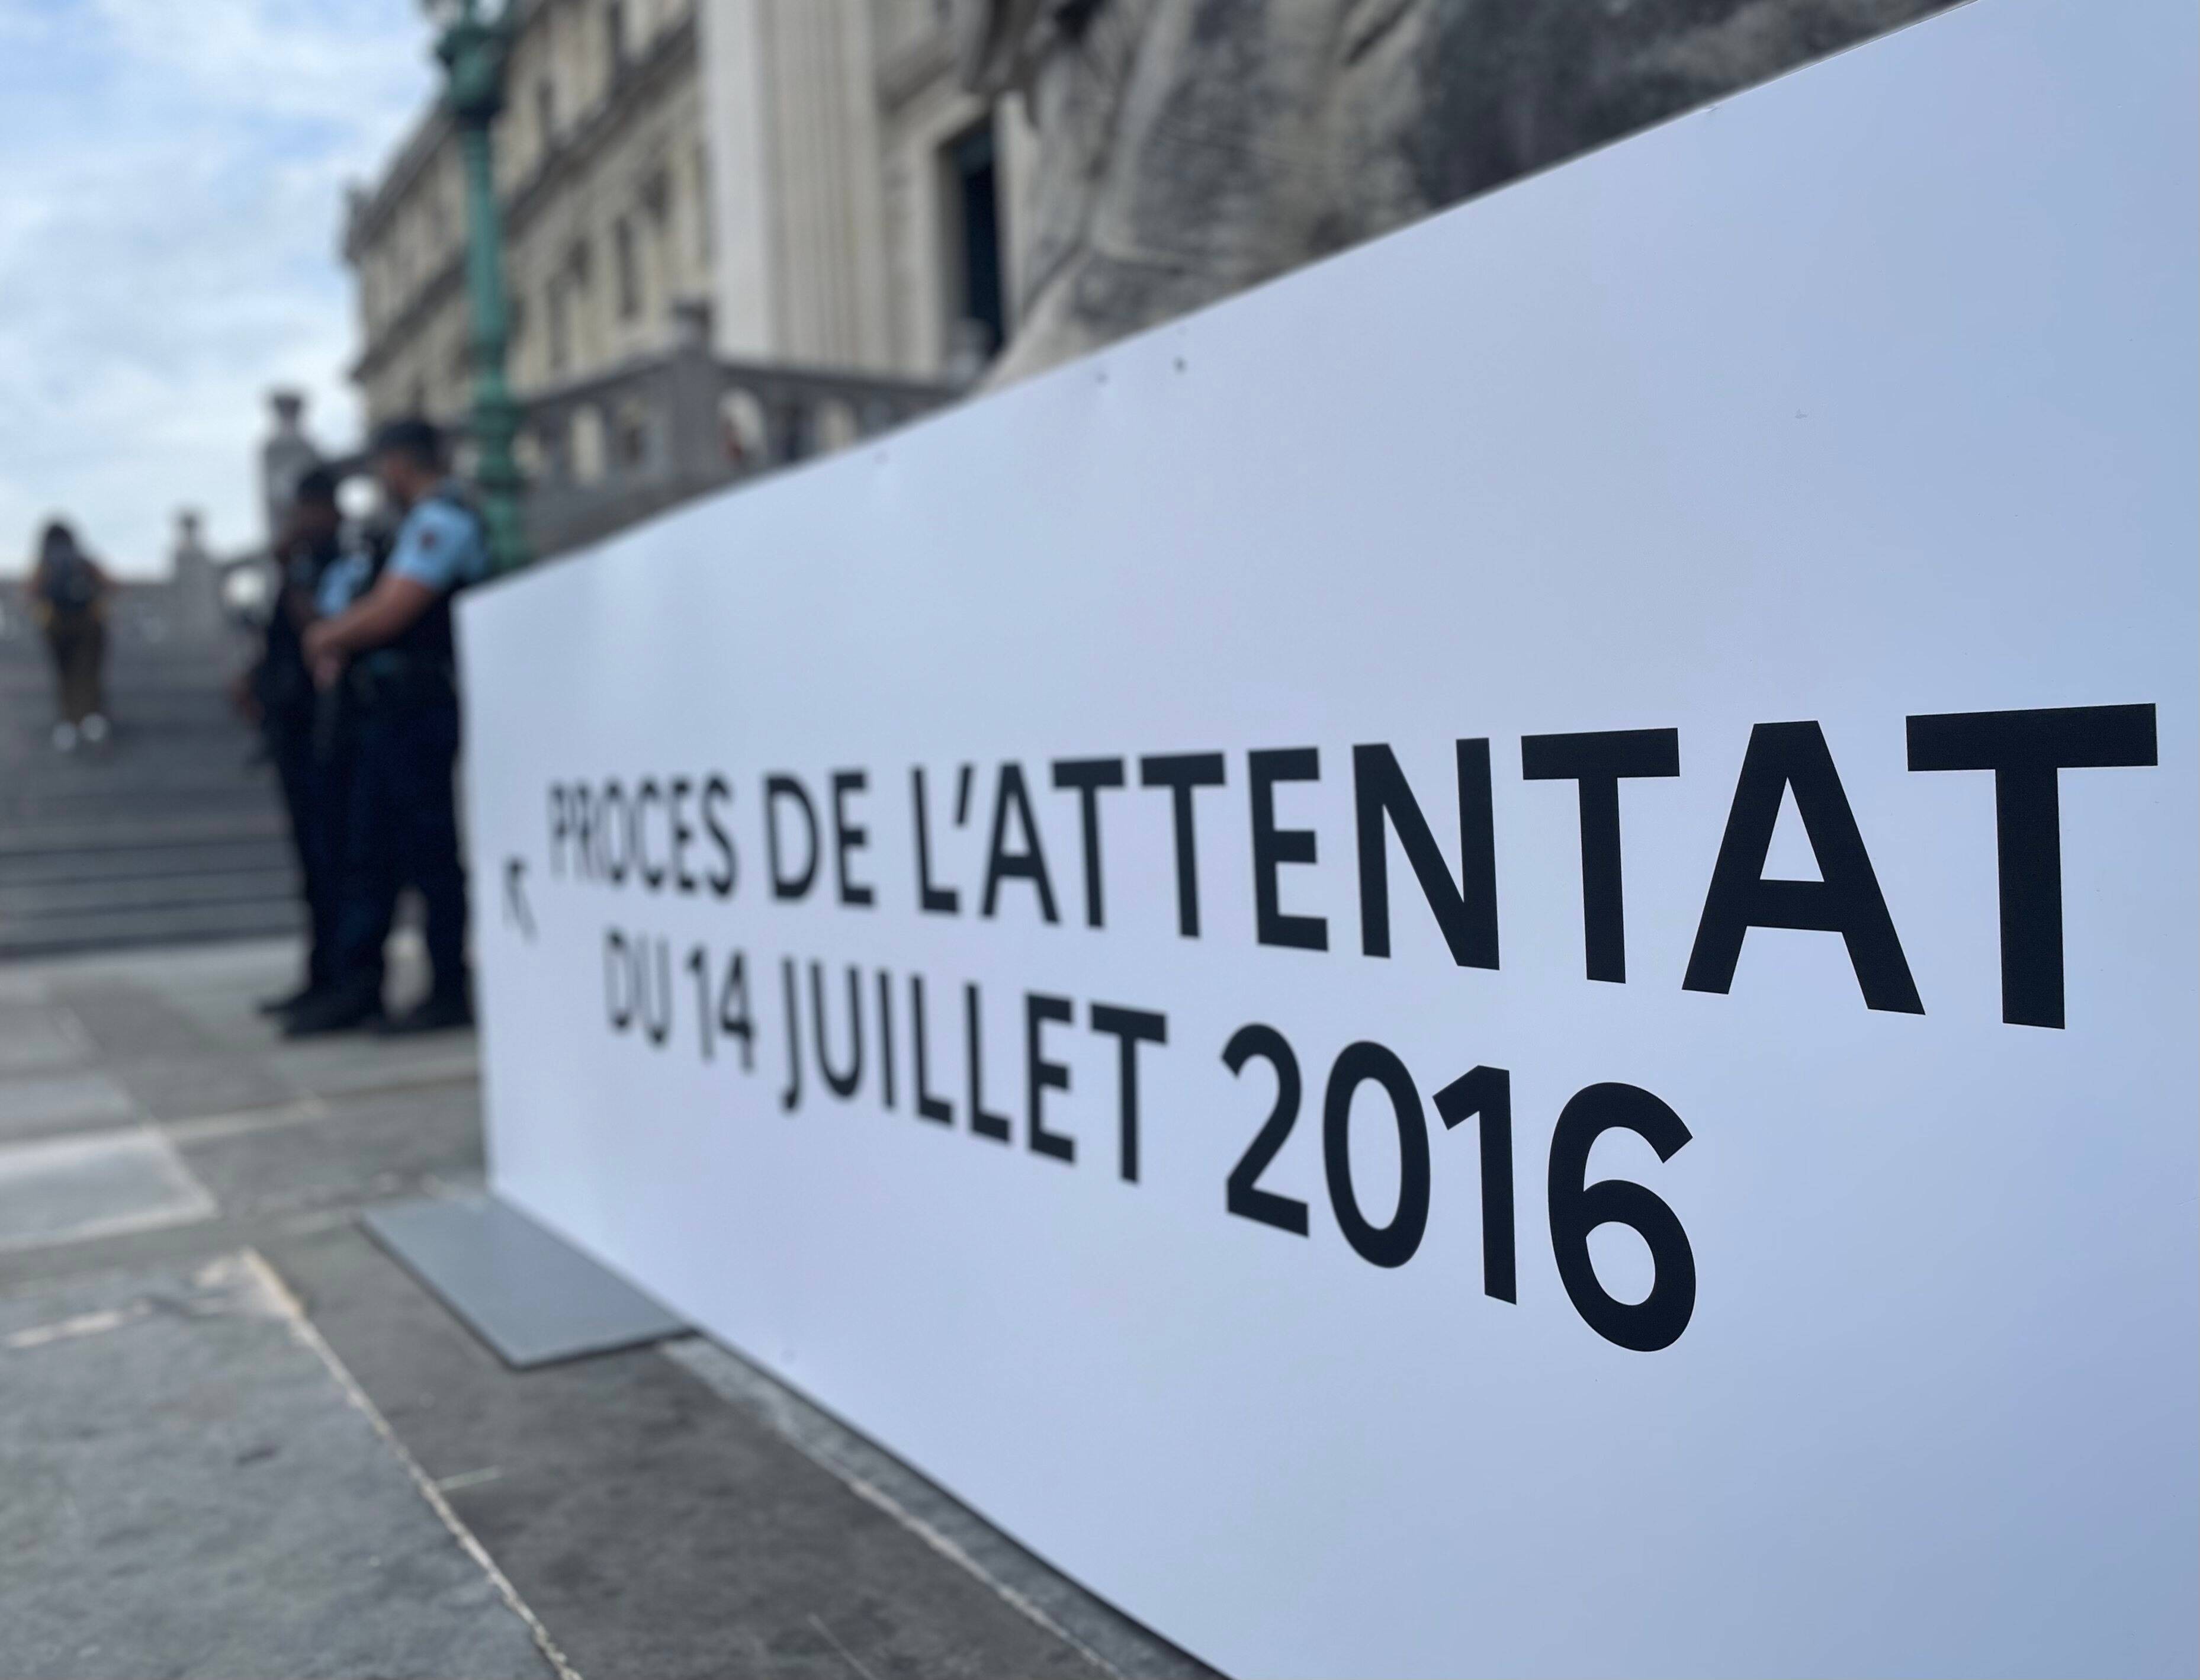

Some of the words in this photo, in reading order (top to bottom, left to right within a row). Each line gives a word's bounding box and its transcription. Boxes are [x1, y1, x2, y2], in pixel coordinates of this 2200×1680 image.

[550, 773, 737, 900] PROCES
[765, 770, 875, 908] DE
[603, 927, 676, 1046] DU
[687, 946, 757, 1074] 14
[780, 961, 1168, 1184] JUILLET
[1222, 1024, 1697, 1353] 2016
